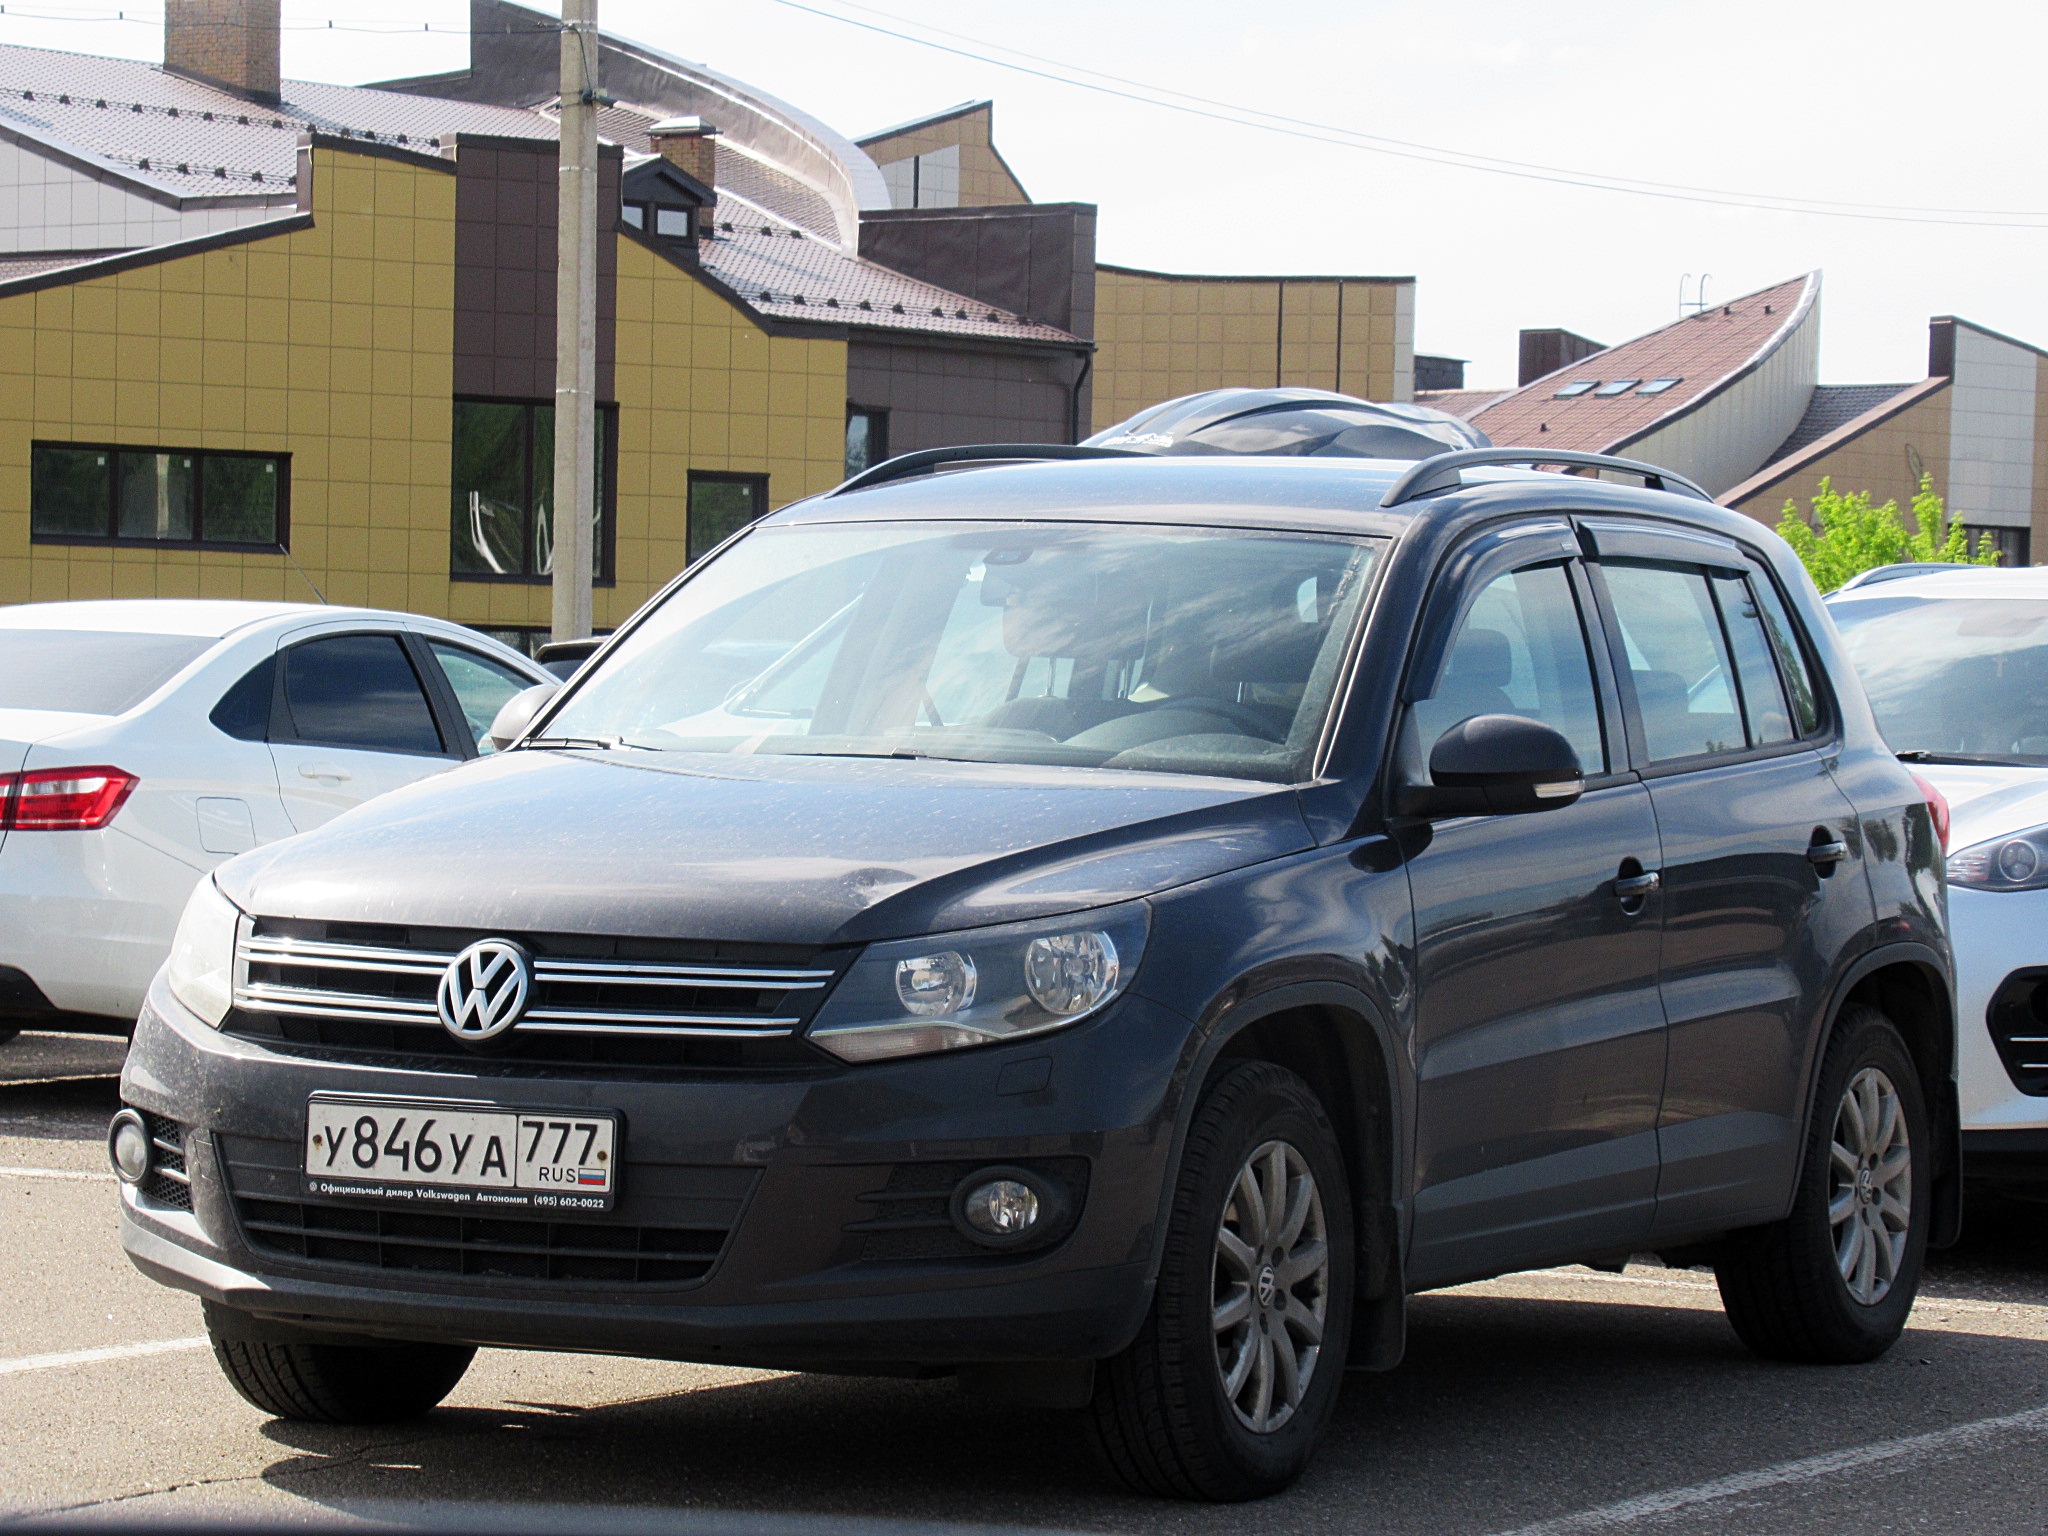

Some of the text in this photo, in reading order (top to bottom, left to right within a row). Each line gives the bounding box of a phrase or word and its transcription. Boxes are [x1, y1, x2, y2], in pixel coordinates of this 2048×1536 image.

[522, 1120, 598, 1166] 777
[538, 1166, 576, 1184] RUS
[320, 1183, 384, 1195] Официальный
[386, 1188, 414, 1199] дилер
[416, 1189, 471, 1202] Volkswagen
[476, 1193, 528, 1204] Автономия
[534, 1194, 557, 1207] (495)
[560, 1197, 604, 1208] 602-0022
